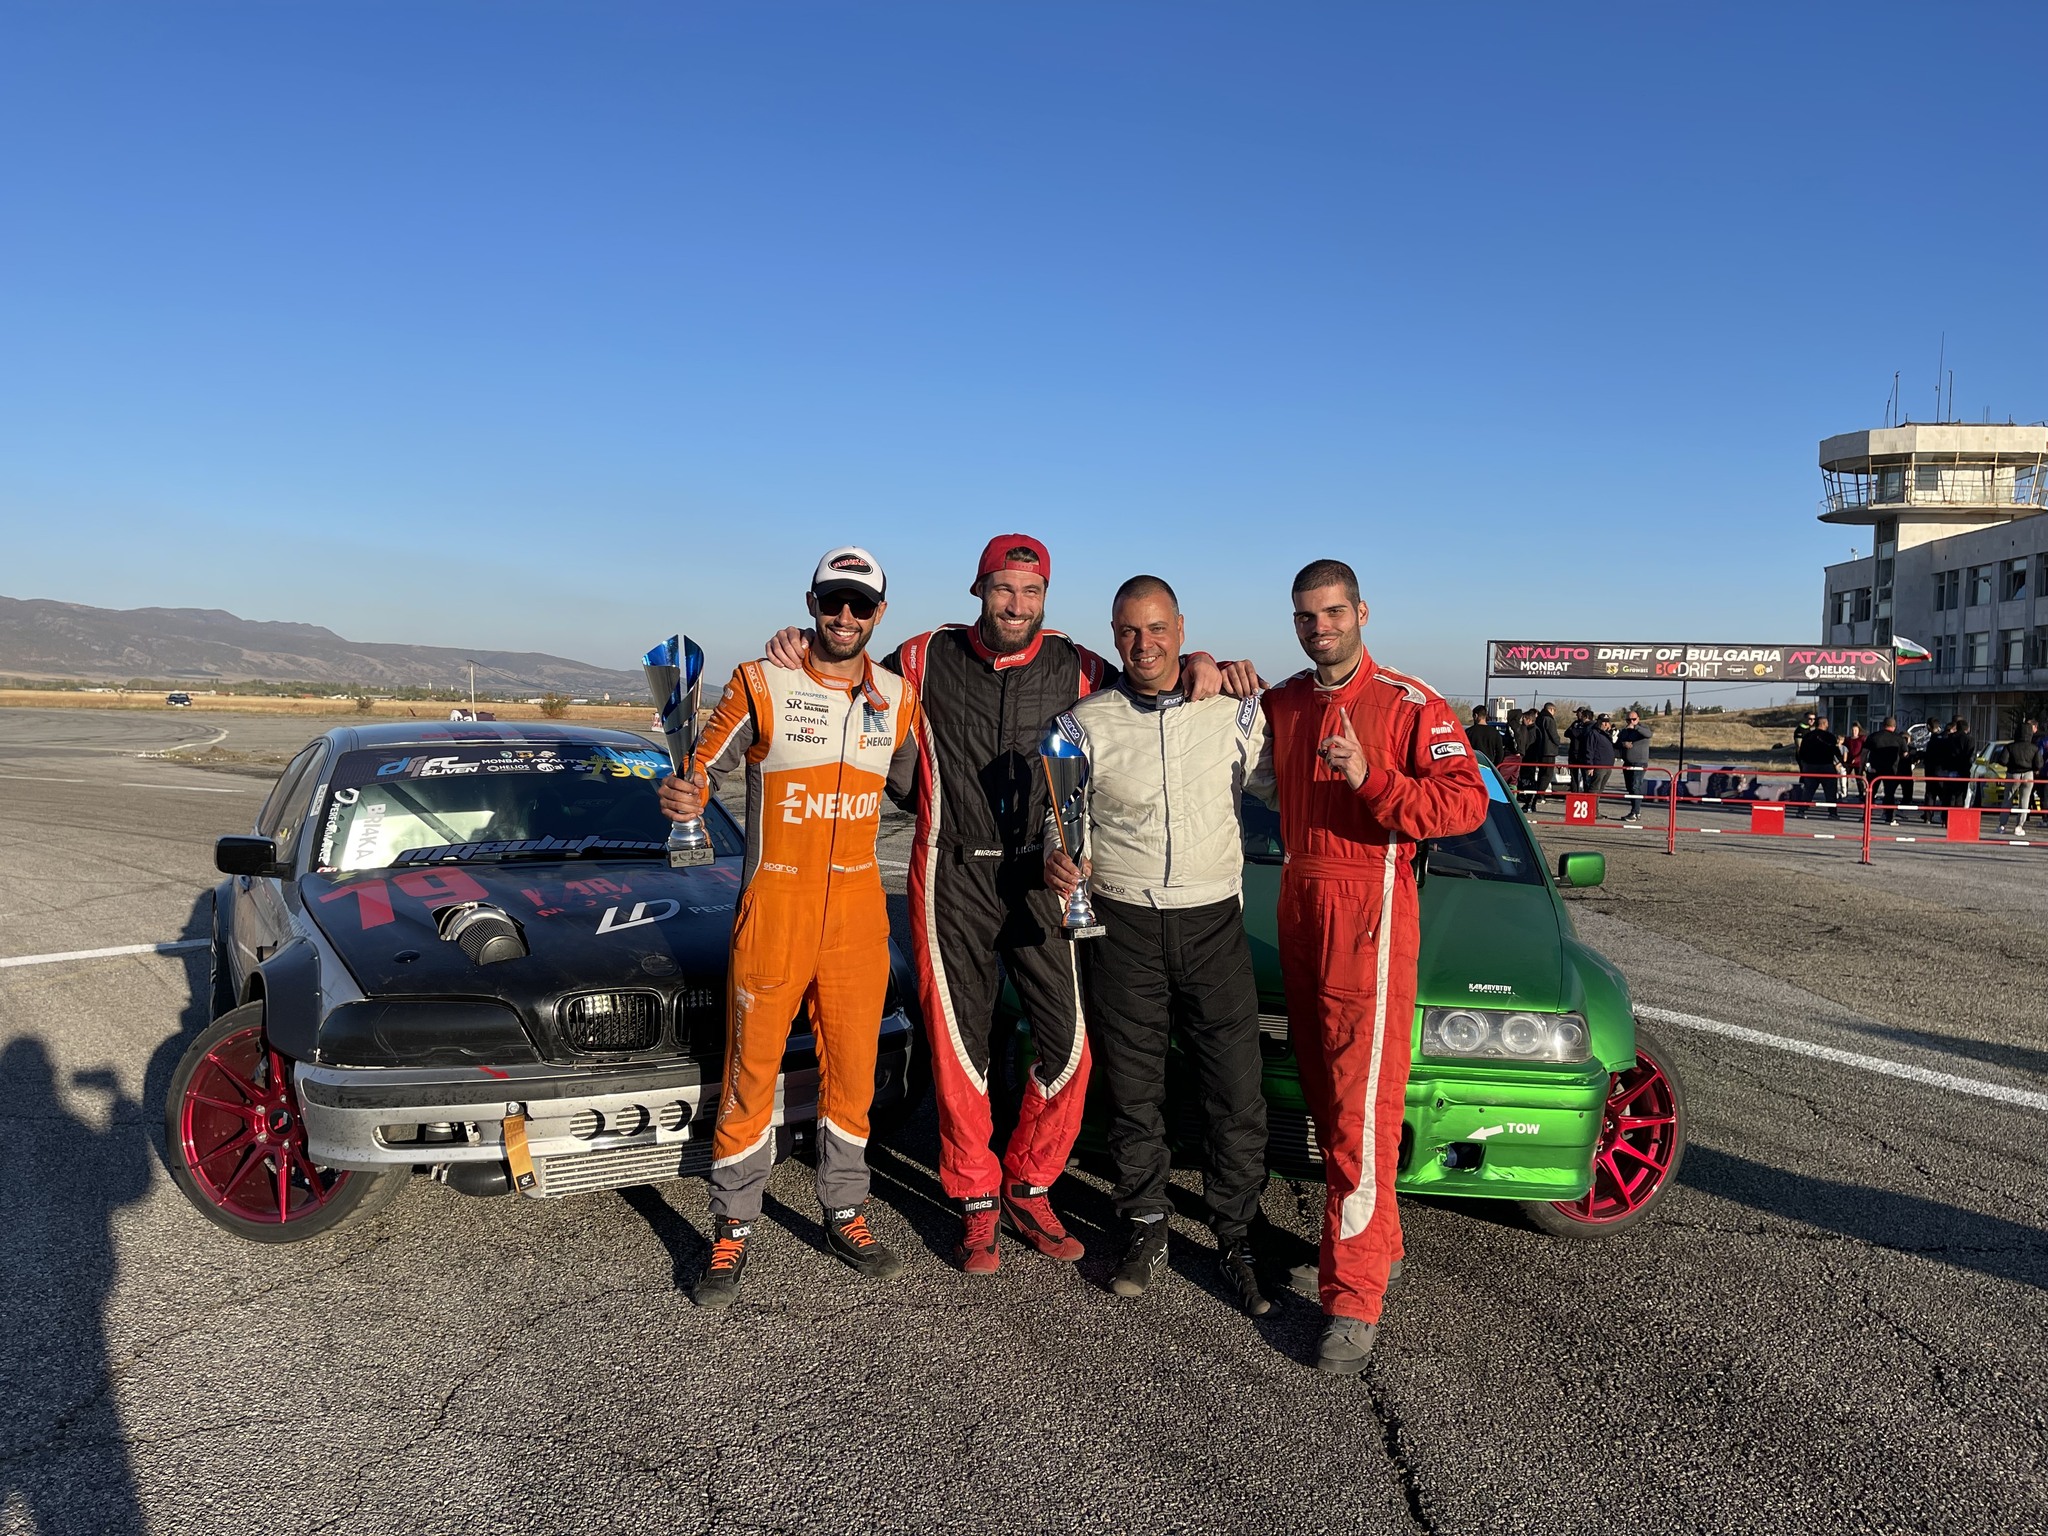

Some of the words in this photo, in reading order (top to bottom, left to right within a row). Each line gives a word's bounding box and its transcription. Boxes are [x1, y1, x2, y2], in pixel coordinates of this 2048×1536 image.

[1506, 646, 1590, 660] ATAUTO
[1597, 648, 1653, 661] DRIFT
[1655, 648, 1683, 661] OF
[1686, 649, 1781, 662] BULGARIA
[1788, 651, 1879, 665] ATAUTO
[1520, 661, 1572, 672] MONBAT
[1820, 665, 1856, 675] HELIOS
[1240, 698, 1254, 727] sparc
[784, 714, 829, 727] GARMIN
[785, 733, 828, 745] TISSOT
[623, 758, 658, 768] PRO
[420, 766, 479, 777] SLIVEN
[1573, 800, 1588, 819] 28
[317, 802, 341, 863] PERFORMANCE
[318, 866, 490, 930] 79
[1507, 1122, 1540, 1135] TOW
[732, 1225, 752, 1238] BOX
